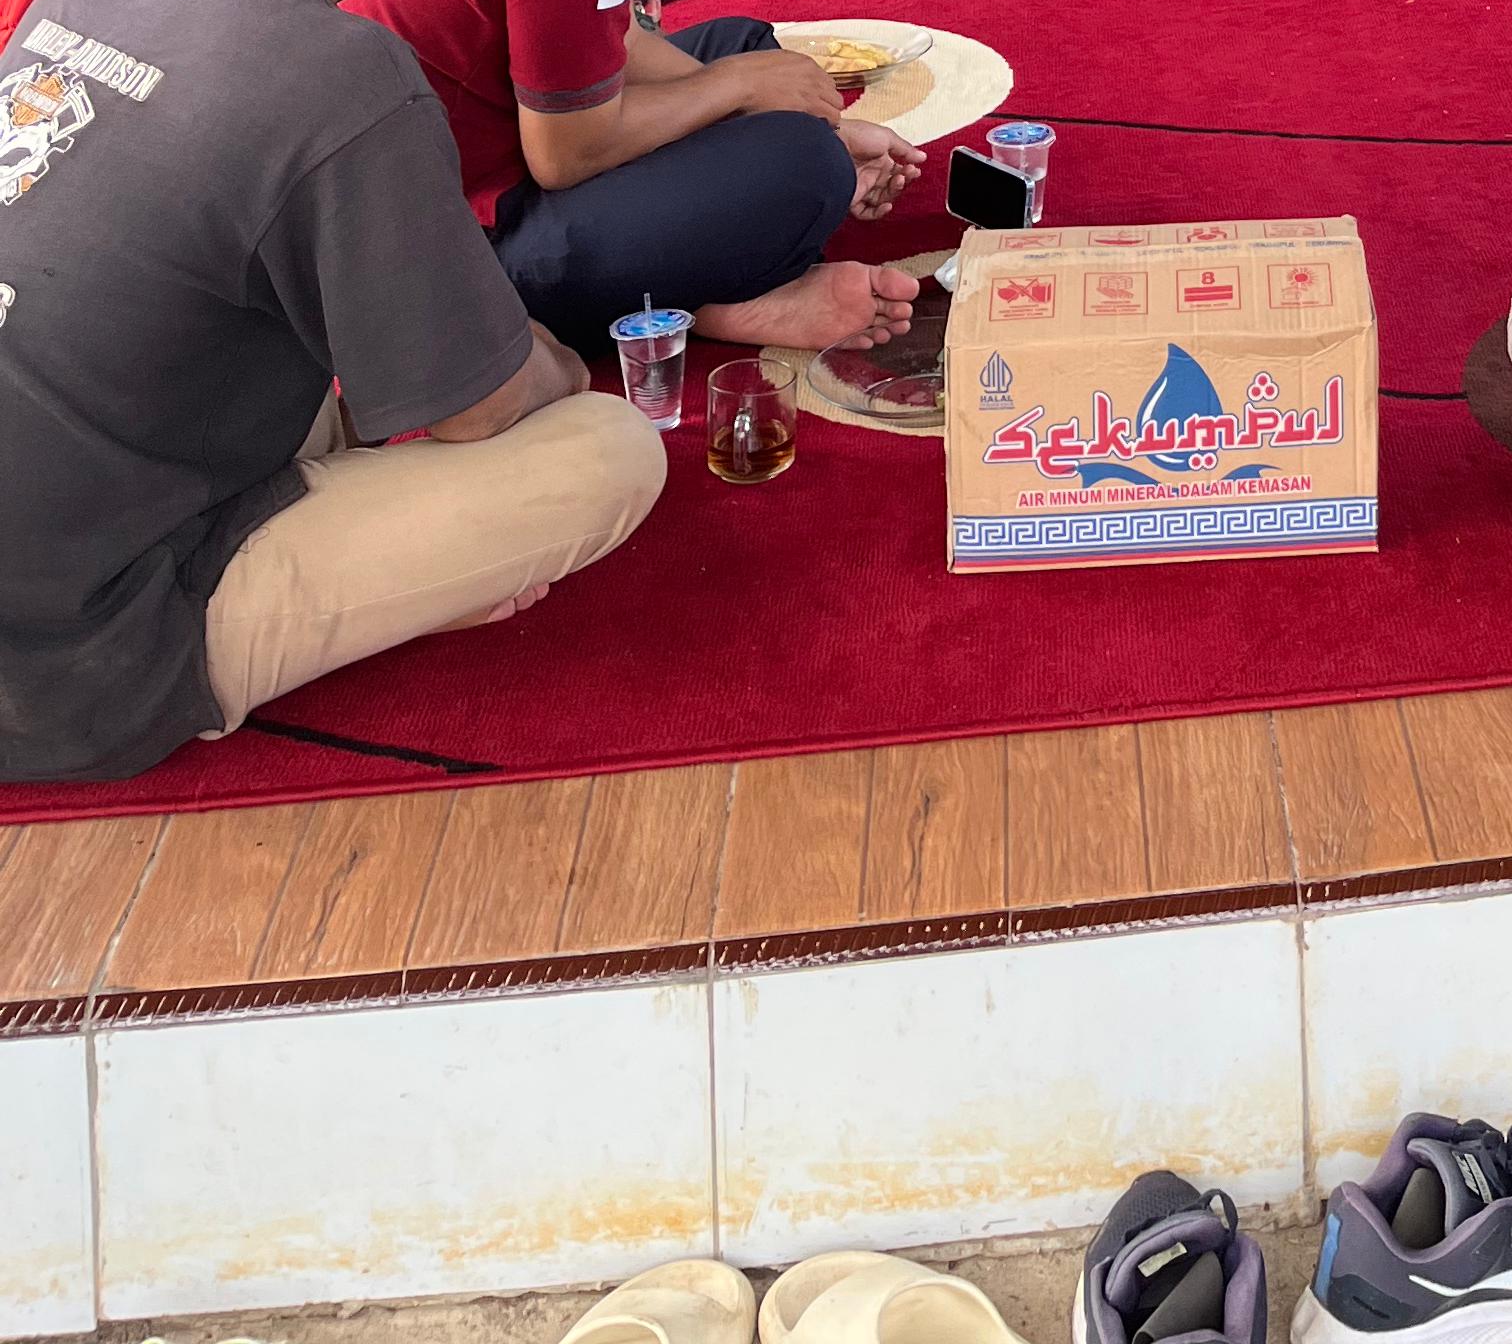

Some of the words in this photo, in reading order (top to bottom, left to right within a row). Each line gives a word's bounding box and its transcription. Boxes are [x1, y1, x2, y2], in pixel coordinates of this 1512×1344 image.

[1018, 492, 1045, 507] AIR
[1050, 489, 1101, 505] MINUM
[1107, 484, 1172, 502] MINERAL
[1179, 480, 1232, 498] DALAM
[1237, 475, 1312, 494] KEMASAN
